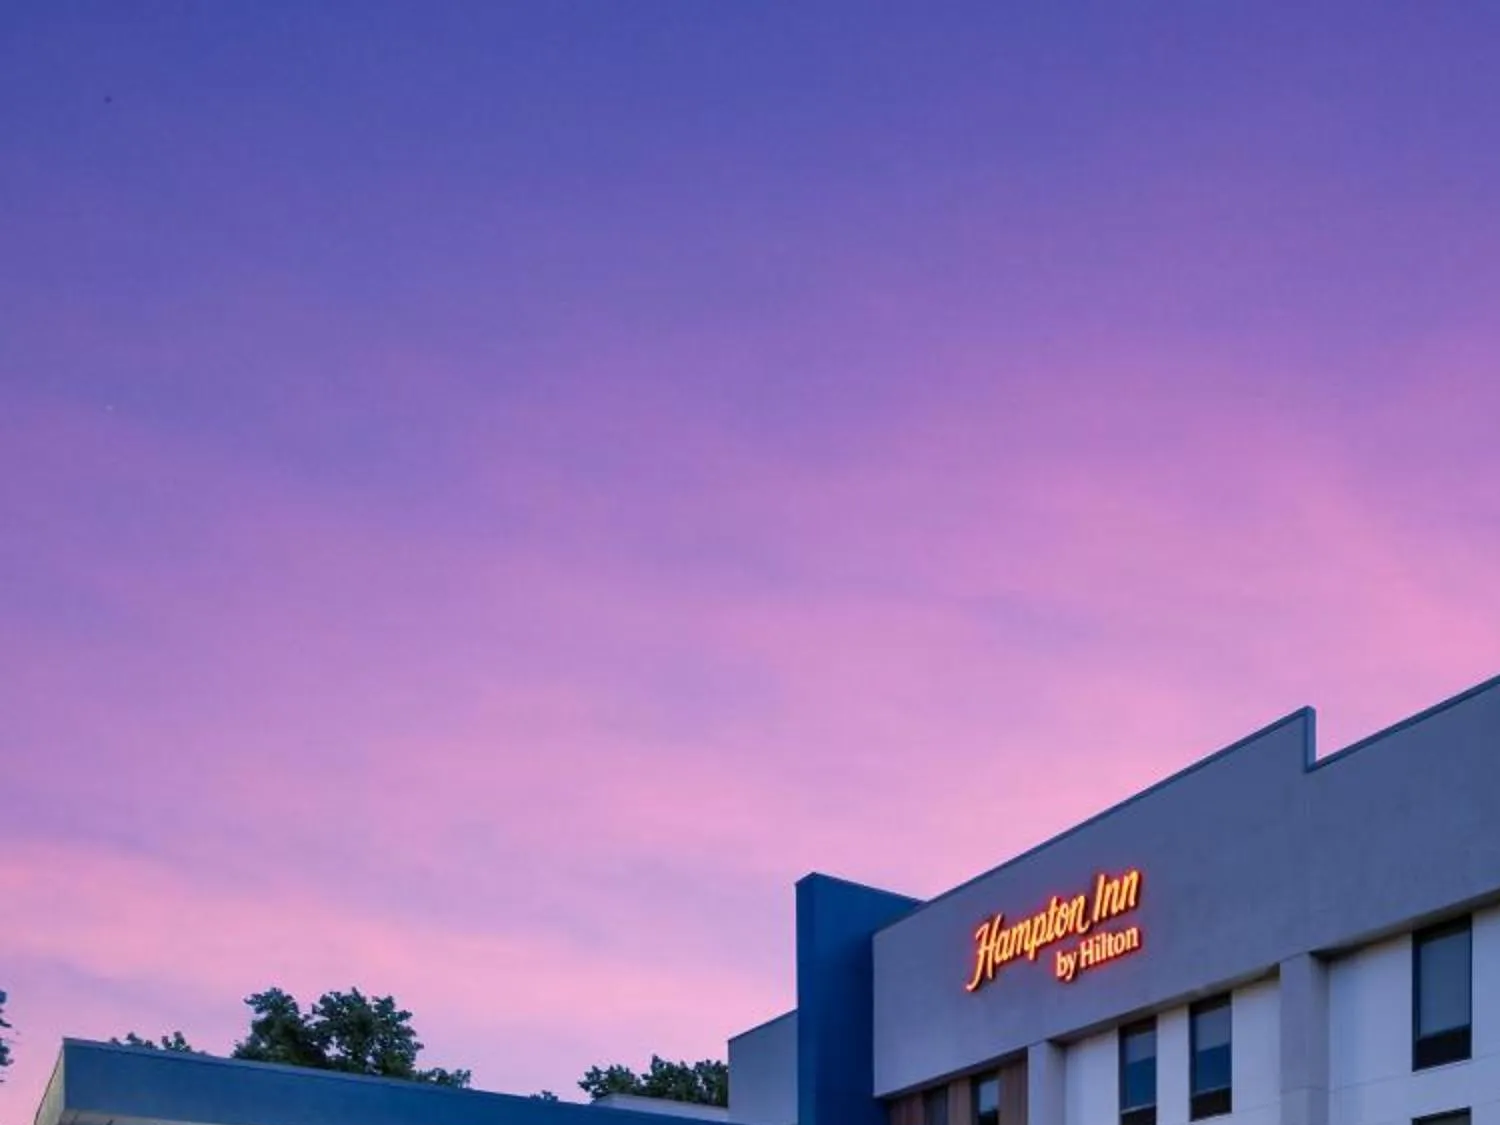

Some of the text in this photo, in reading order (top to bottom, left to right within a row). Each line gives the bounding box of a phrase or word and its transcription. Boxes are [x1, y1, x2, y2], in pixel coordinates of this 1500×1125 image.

[965, 869, 1141, 992] Hampton Inn
[1055, 927, 1140, 982] by Hilton
